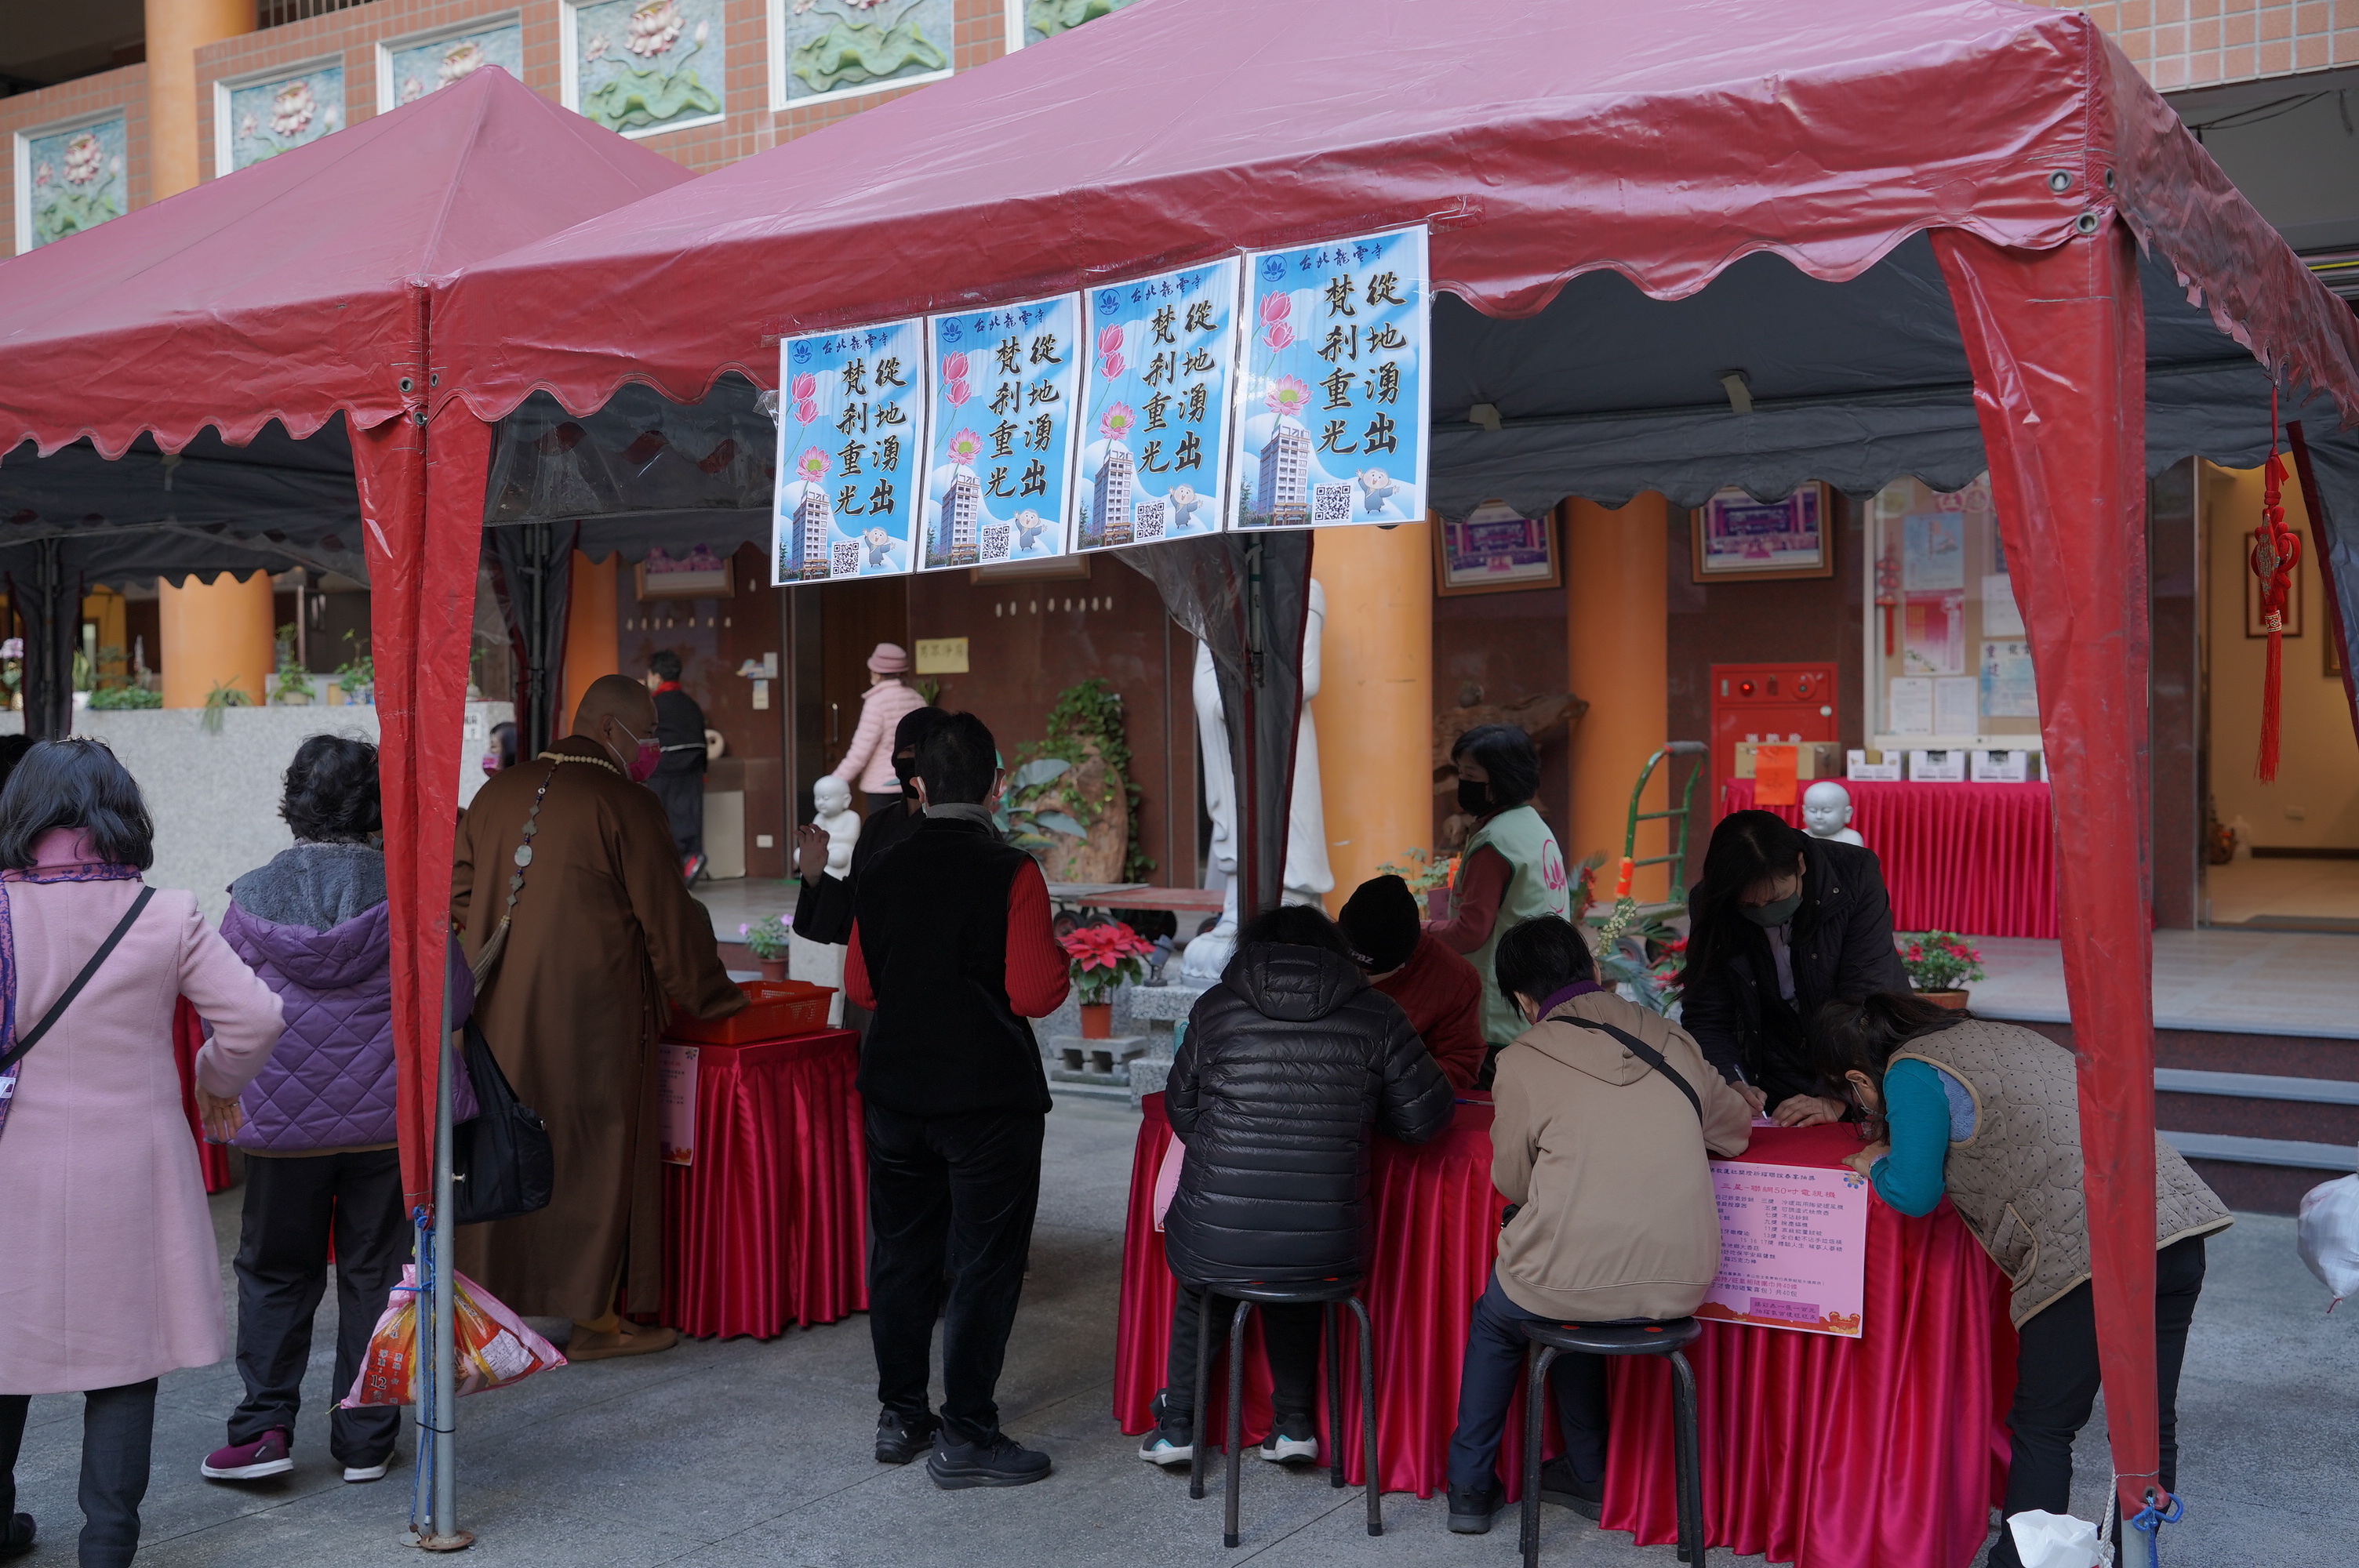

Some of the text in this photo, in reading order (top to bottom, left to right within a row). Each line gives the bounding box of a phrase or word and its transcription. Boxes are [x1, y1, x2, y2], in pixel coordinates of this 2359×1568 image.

[1130, 274, 1202, 303] 台北龍雲寺
[1298, 242, 1383, 271] 台北龍雲寺
[822, 332, 888, 356] 台北龍雲寺
[973, 308, 1045, 333] 台北龍雲寺
[1362, 270, 1407, 456] 從地湧出
[1020, 333, 1062, 498] 從地湧出
[1174, 299, 1218, 473] 從地湧出
[868, 358, 907, 516] 從地湧出
